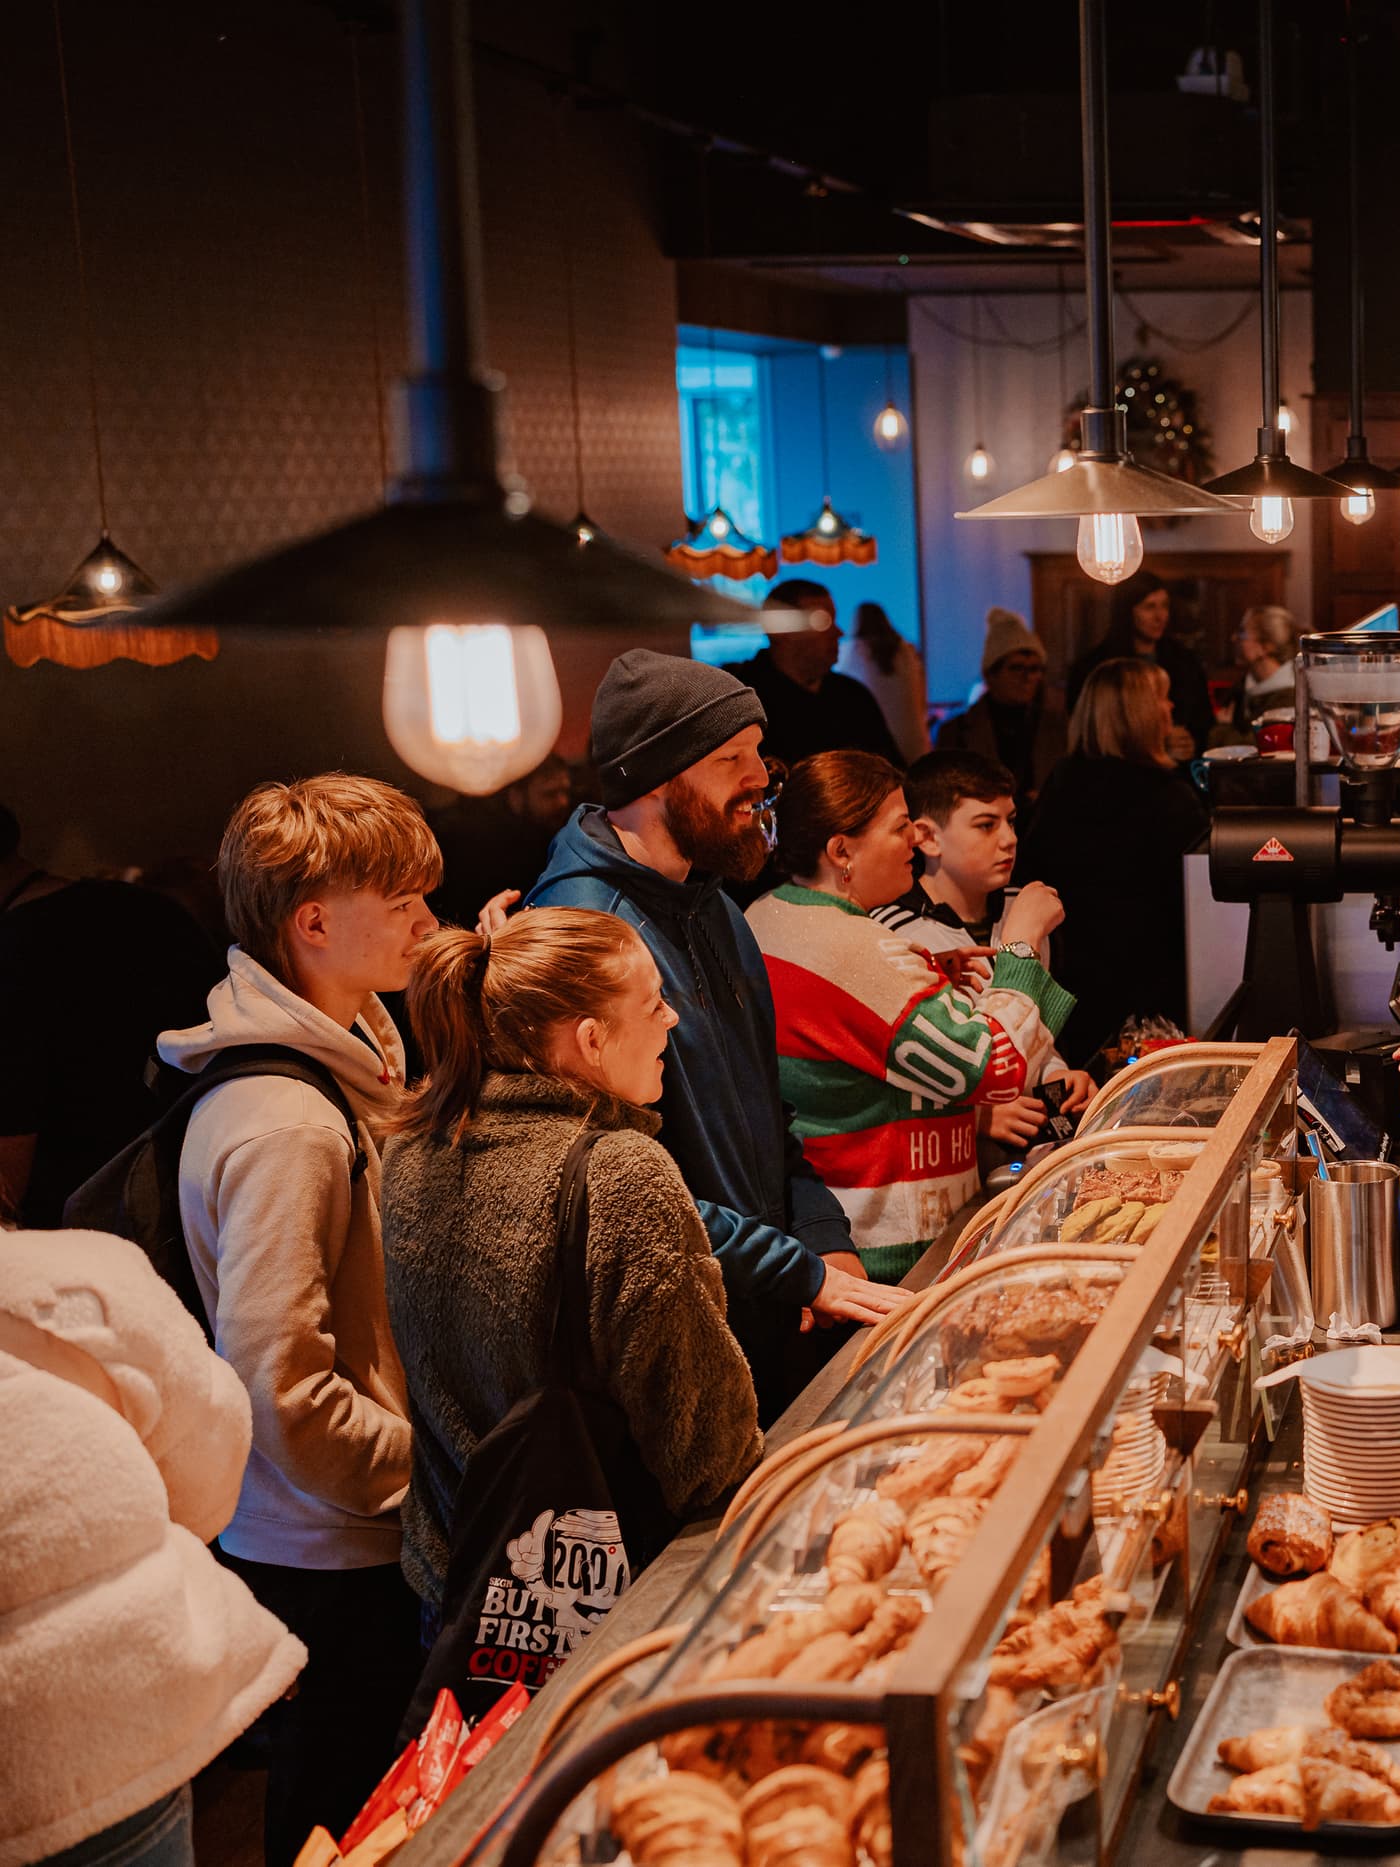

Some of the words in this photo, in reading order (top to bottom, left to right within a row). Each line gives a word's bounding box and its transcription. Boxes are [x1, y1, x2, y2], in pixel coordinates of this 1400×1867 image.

[910, 1129, 940, 1170] HO
[481, 1585, 553, 1621] BUT
[475, 1616, 575, 1655] FIRST
